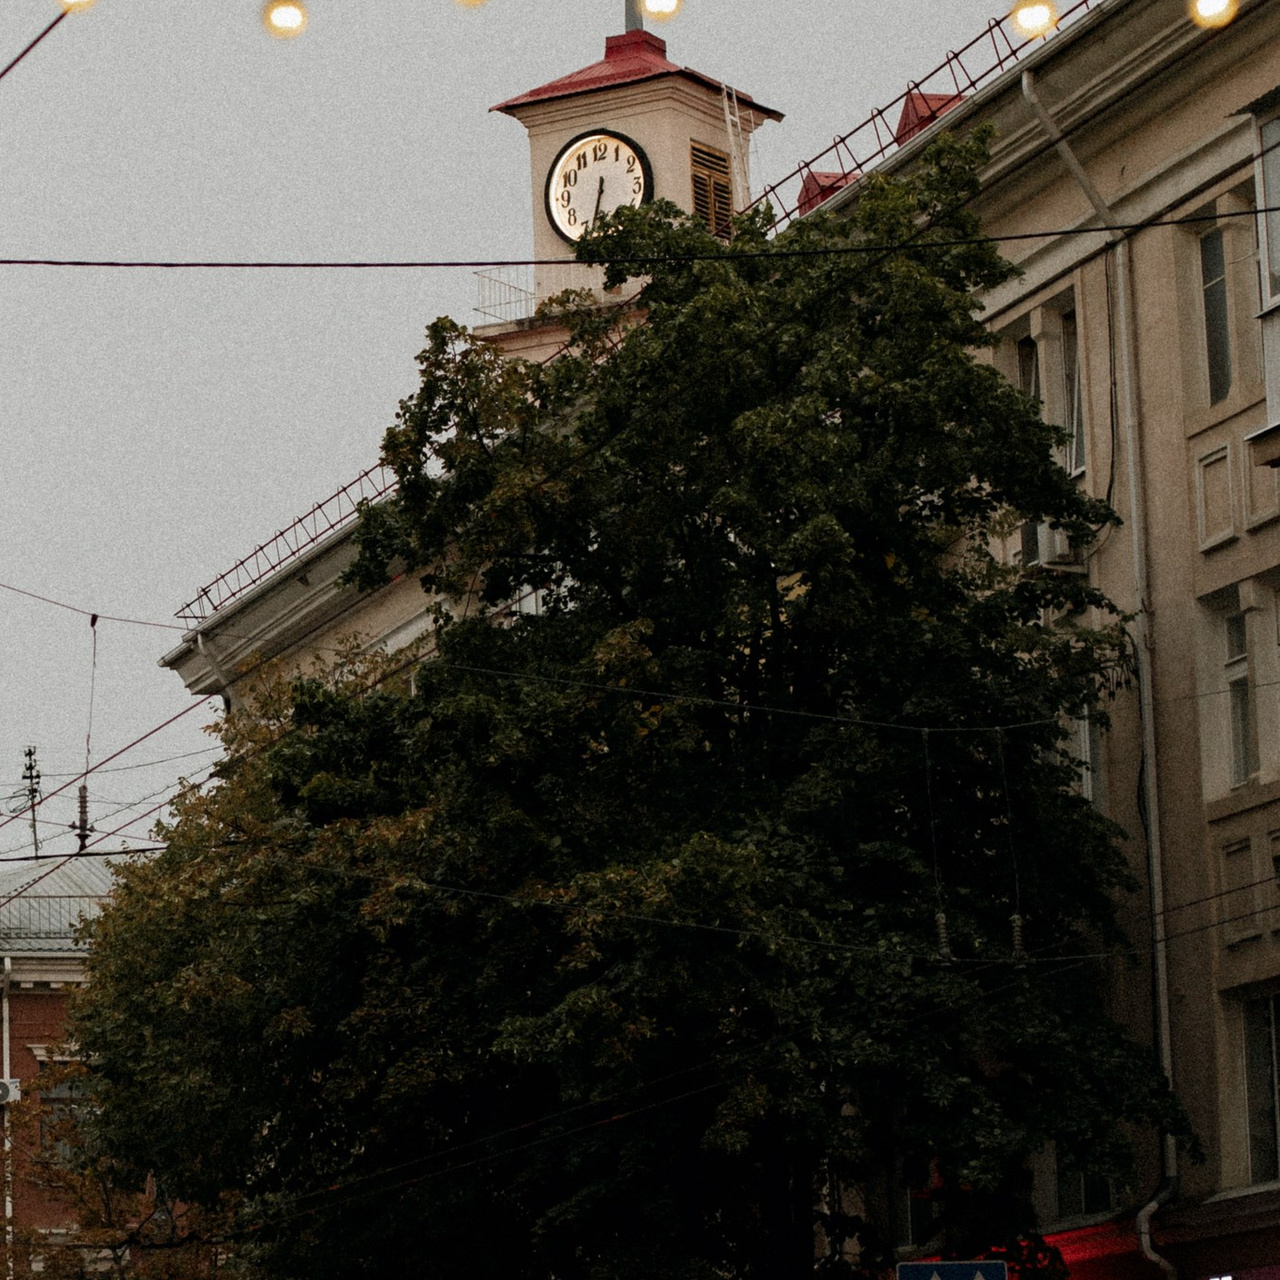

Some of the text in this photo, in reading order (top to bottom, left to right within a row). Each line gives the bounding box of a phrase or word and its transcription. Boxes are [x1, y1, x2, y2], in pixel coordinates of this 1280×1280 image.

[576, 151, 587, 170] 11
[593, 143, 607, 162] 12
[614, 144, 620, 162] 1
[626, 154, 636, 174] 2
[563, 169, 577, 188] 10
[632, 176, 642, 195] 3
[561, 189, 571, 208] 9
[567, 207, 577, 226] 8
